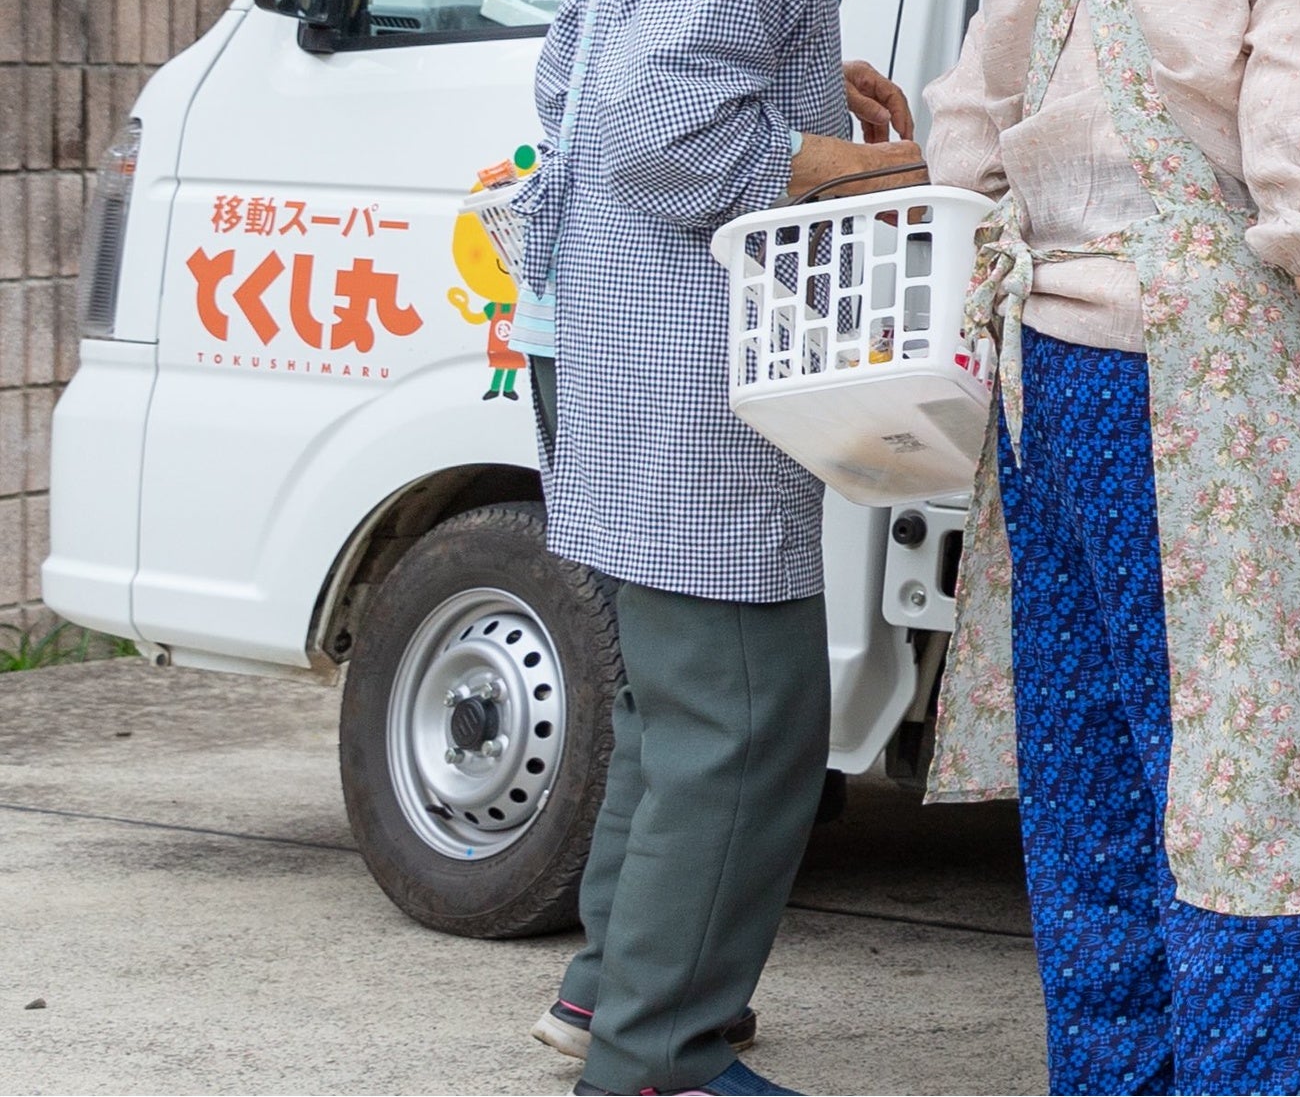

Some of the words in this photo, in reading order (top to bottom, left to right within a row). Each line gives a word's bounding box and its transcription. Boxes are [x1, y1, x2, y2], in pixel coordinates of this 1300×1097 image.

[212, 193, 410, 239] 移動スーパー
[186, 245, 424, 354] とくし丸
[197, 352, 390, 379] TOKUSHIMARU
